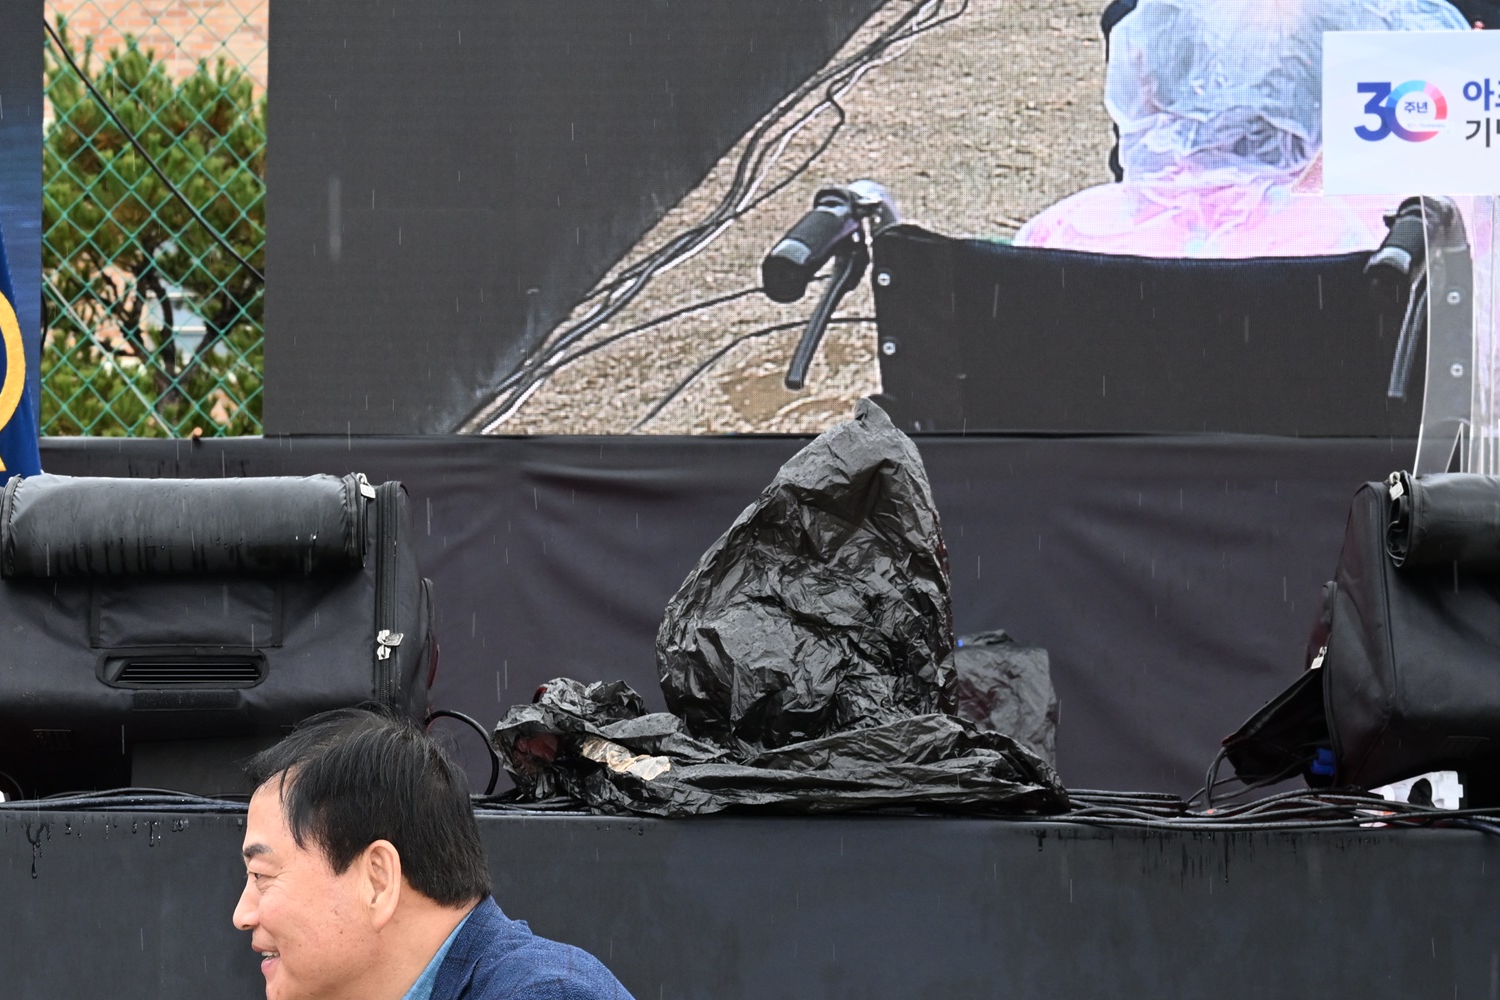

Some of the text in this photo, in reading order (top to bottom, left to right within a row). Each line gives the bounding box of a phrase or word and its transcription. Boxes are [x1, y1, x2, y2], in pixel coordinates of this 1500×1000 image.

[1354, 79, 1448, 143] 30
[1404, 101, 1428, 113] 주년
[1462, 78, 1500, 111] 아
